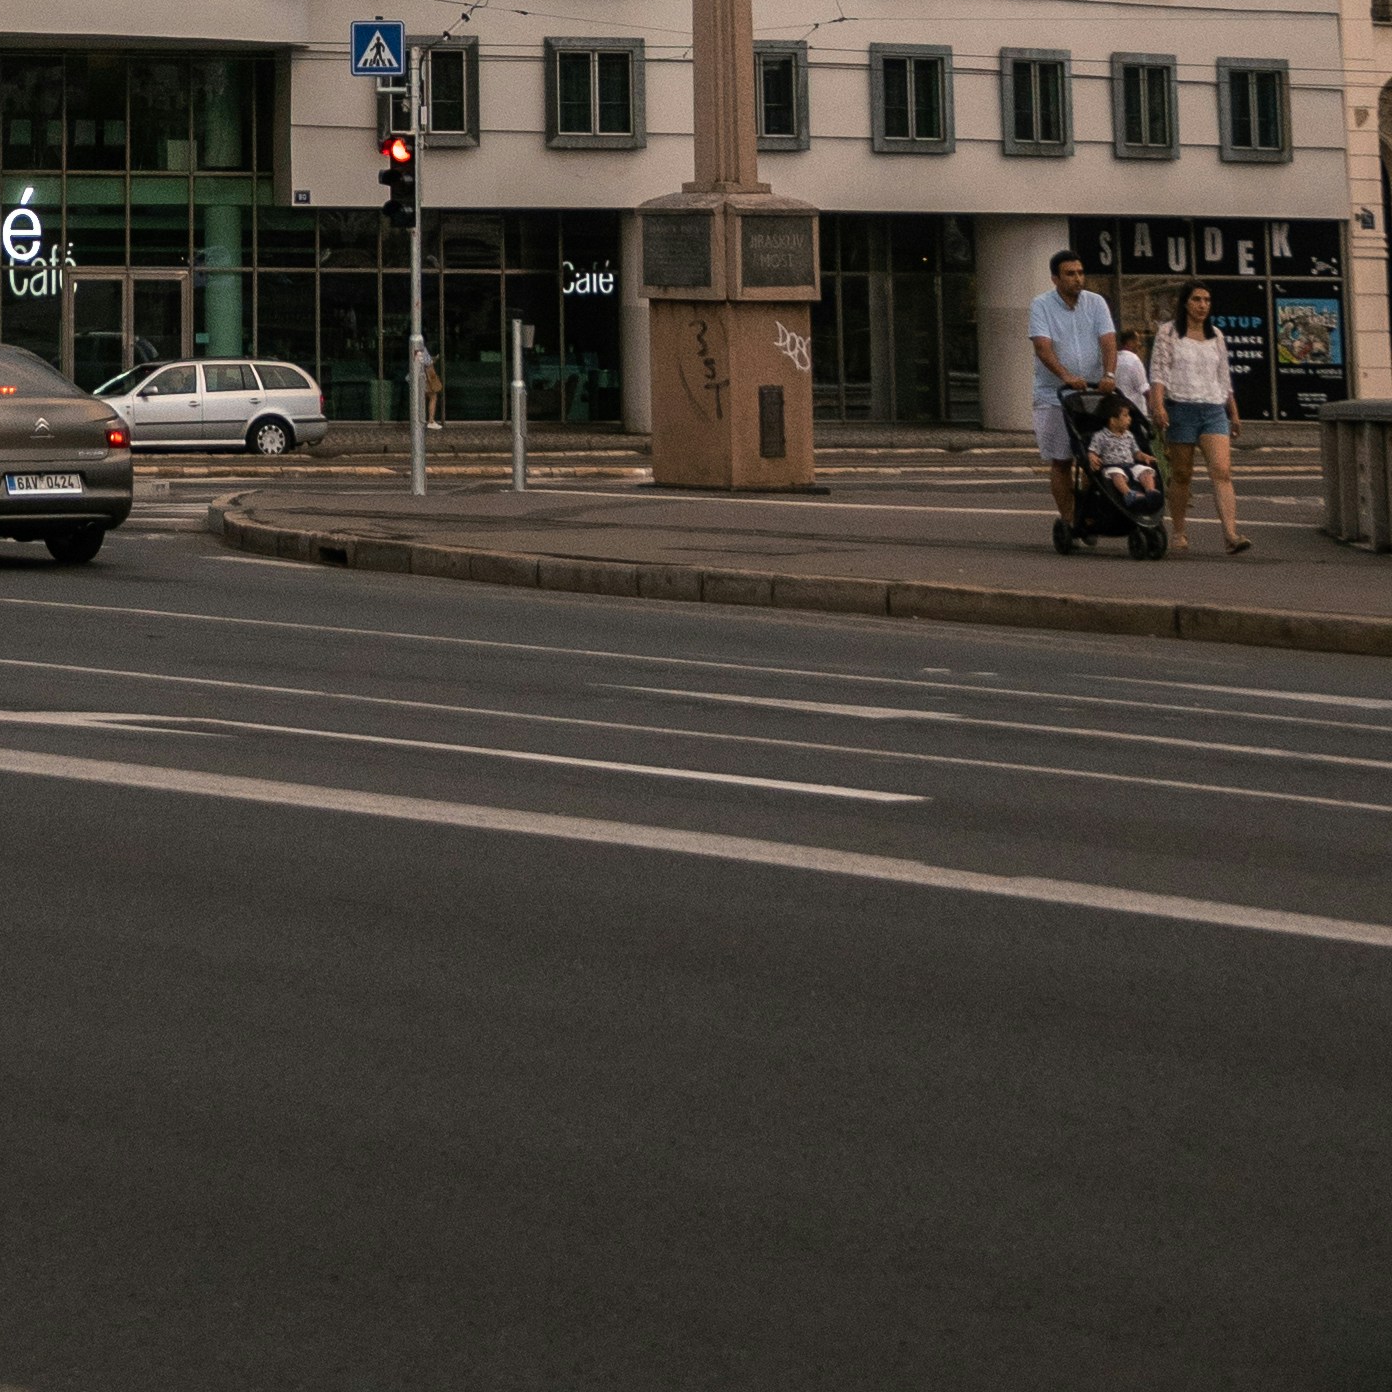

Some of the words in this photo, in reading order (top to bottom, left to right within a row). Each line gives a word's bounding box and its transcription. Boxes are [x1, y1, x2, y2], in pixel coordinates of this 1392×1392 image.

[1099, 222, 1293, 275] SAUDEK
[562, 259, 615, 294] Café
[17, 475, 39, 490] 6AV
[46, 475, 74, 490] 0424
